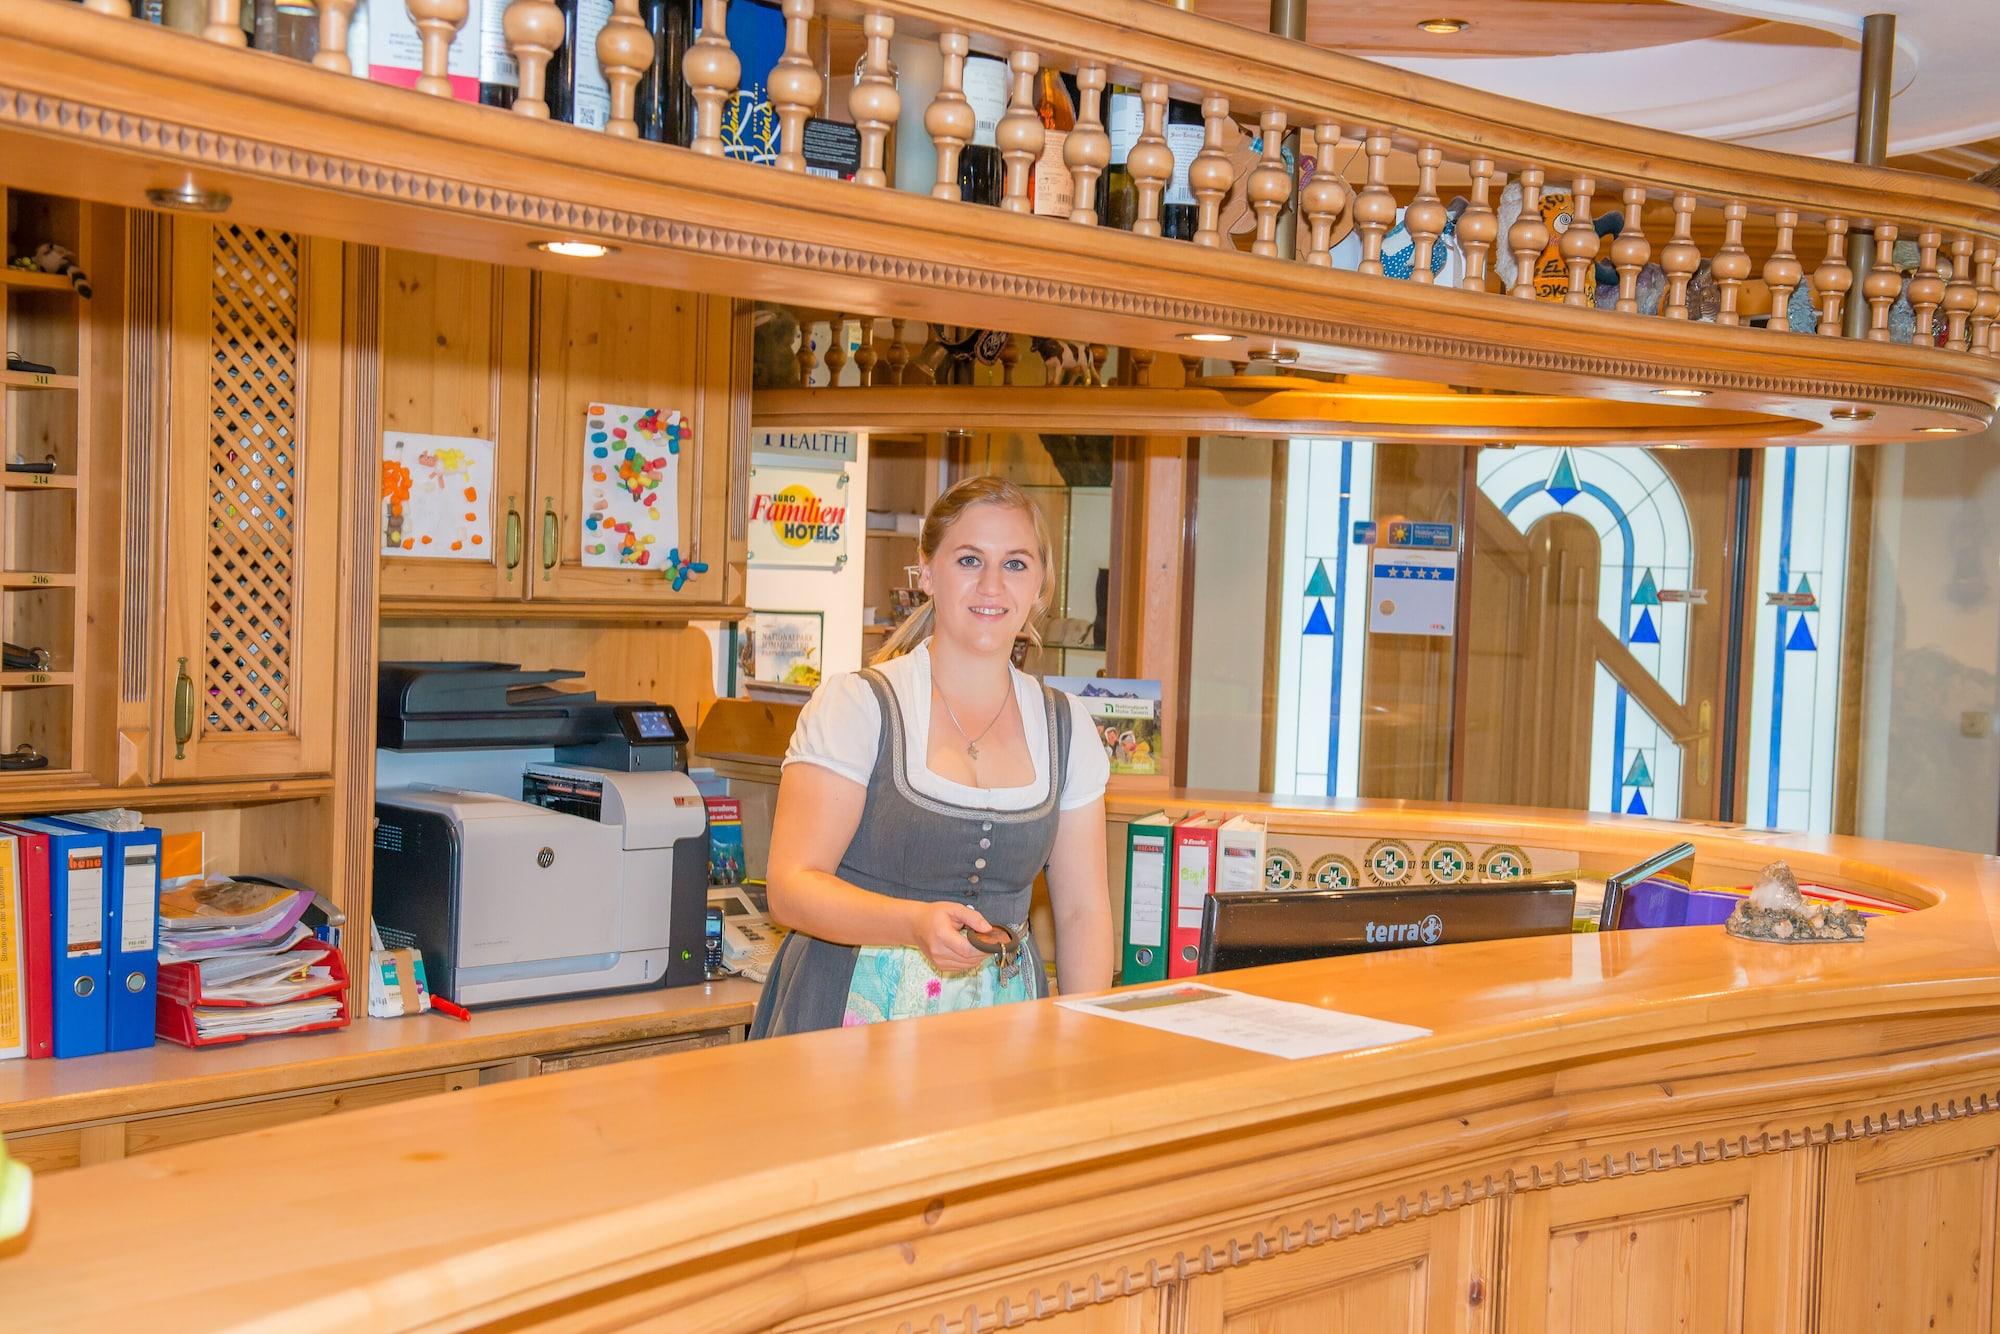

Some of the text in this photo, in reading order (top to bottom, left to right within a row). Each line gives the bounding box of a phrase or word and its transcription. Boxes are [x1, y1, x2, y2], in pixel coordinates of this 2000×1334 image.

[33, 374, 48, 385] 311
[33, 474, 48, 485] 214
[773, 494, 796, 503] EURO
[751, 494, 846, 525] Familien
[784, 523, 840, 541] HOTELS
[32, 574, 48, 585] 206
[31, 674, 46, 684] 116
[68, 853, 102, 870] bene
[1407, 860, 1417, 870] 07
[1421, 859, 1430, 869] 20
[1477, 863, 1487, 873] 20
[1366, 921, 1420, 943] terra
